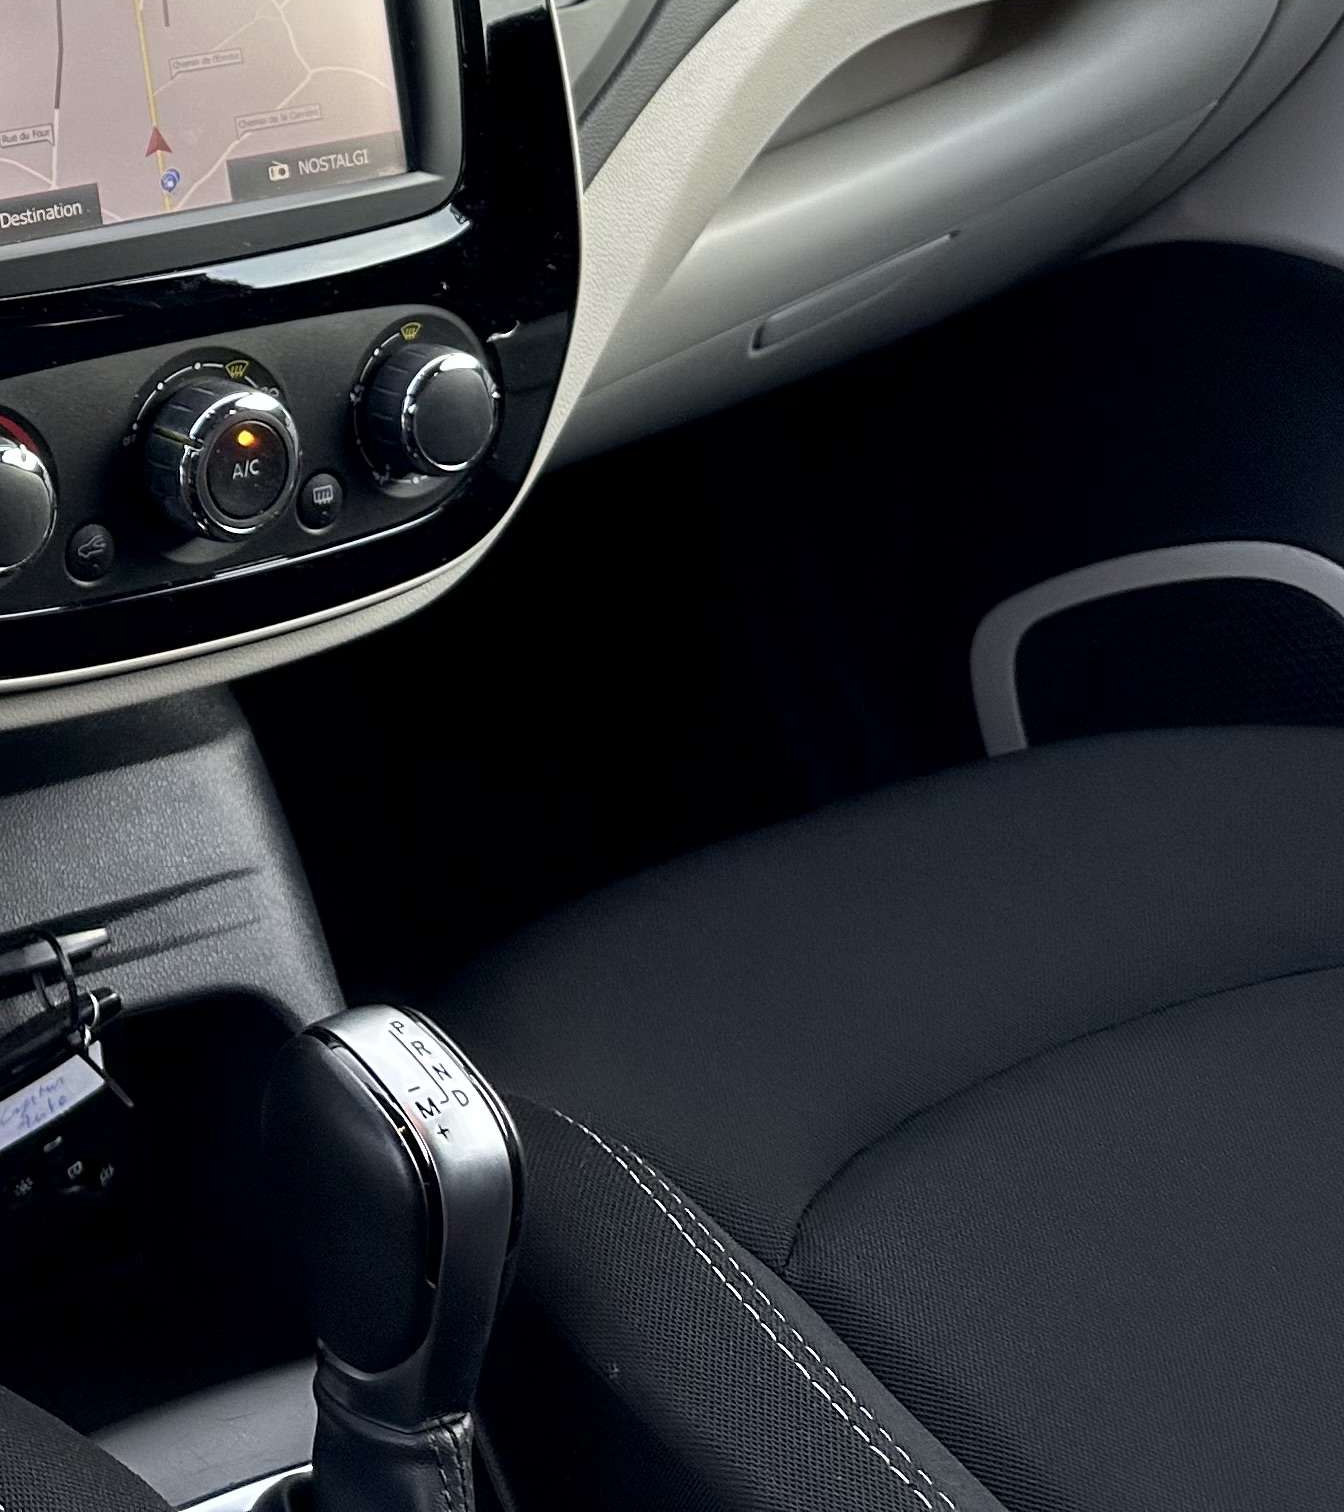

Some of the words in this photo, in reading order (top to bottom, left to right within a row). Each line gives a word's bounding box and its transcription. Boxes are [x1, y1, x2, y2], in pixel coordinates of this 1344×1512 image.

[0, 201, 83, 229] Destination
[232, 458, 261, 480] A/C
[390, 1020, 405, 1035] P
[410, 1040, 433, 1056] R
[432, 1062, 453, 1081] N
[450, 1089, 470, 1107] D
[415, 1097, 442, 1119] M
